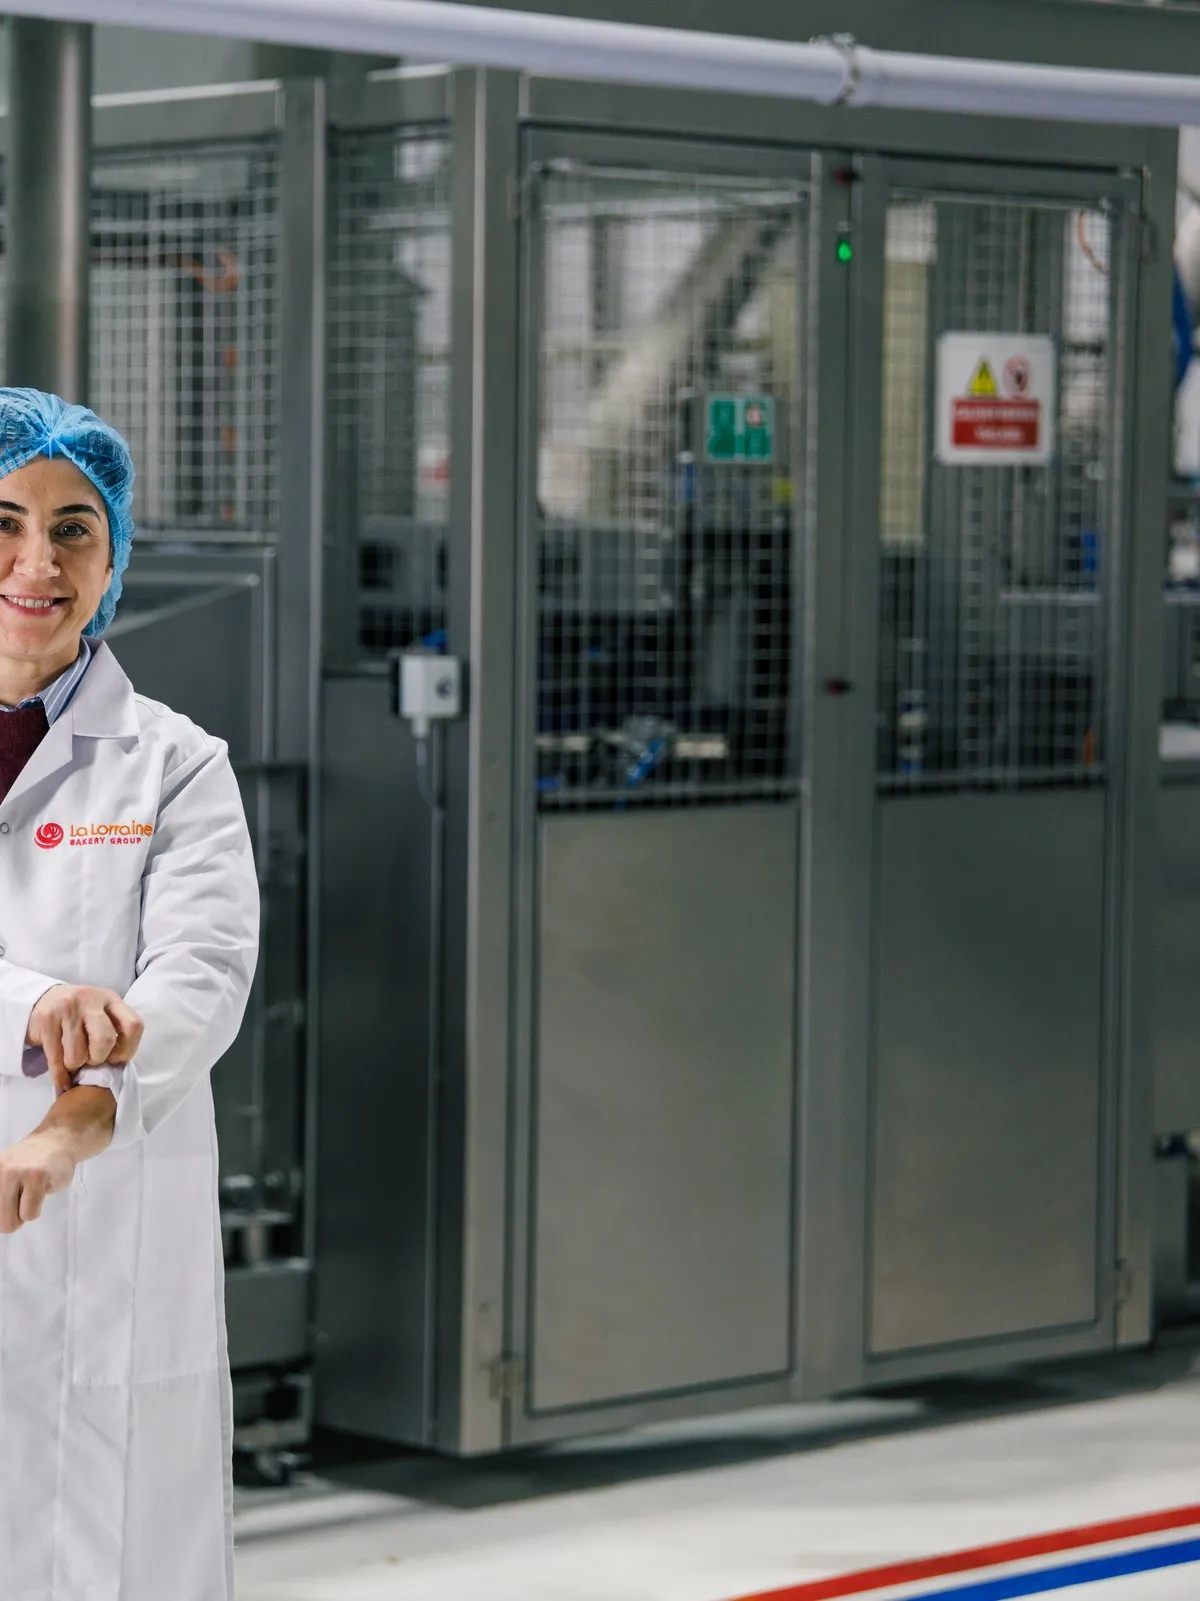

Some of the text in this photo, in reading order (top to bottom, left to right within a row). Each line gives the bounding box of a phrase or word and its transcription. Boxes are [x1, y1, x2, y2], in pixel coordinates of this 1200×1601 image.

[70, 820, 153, 837] La Lorraine
[70, 837, 142, 846] BAKERY GROUP
